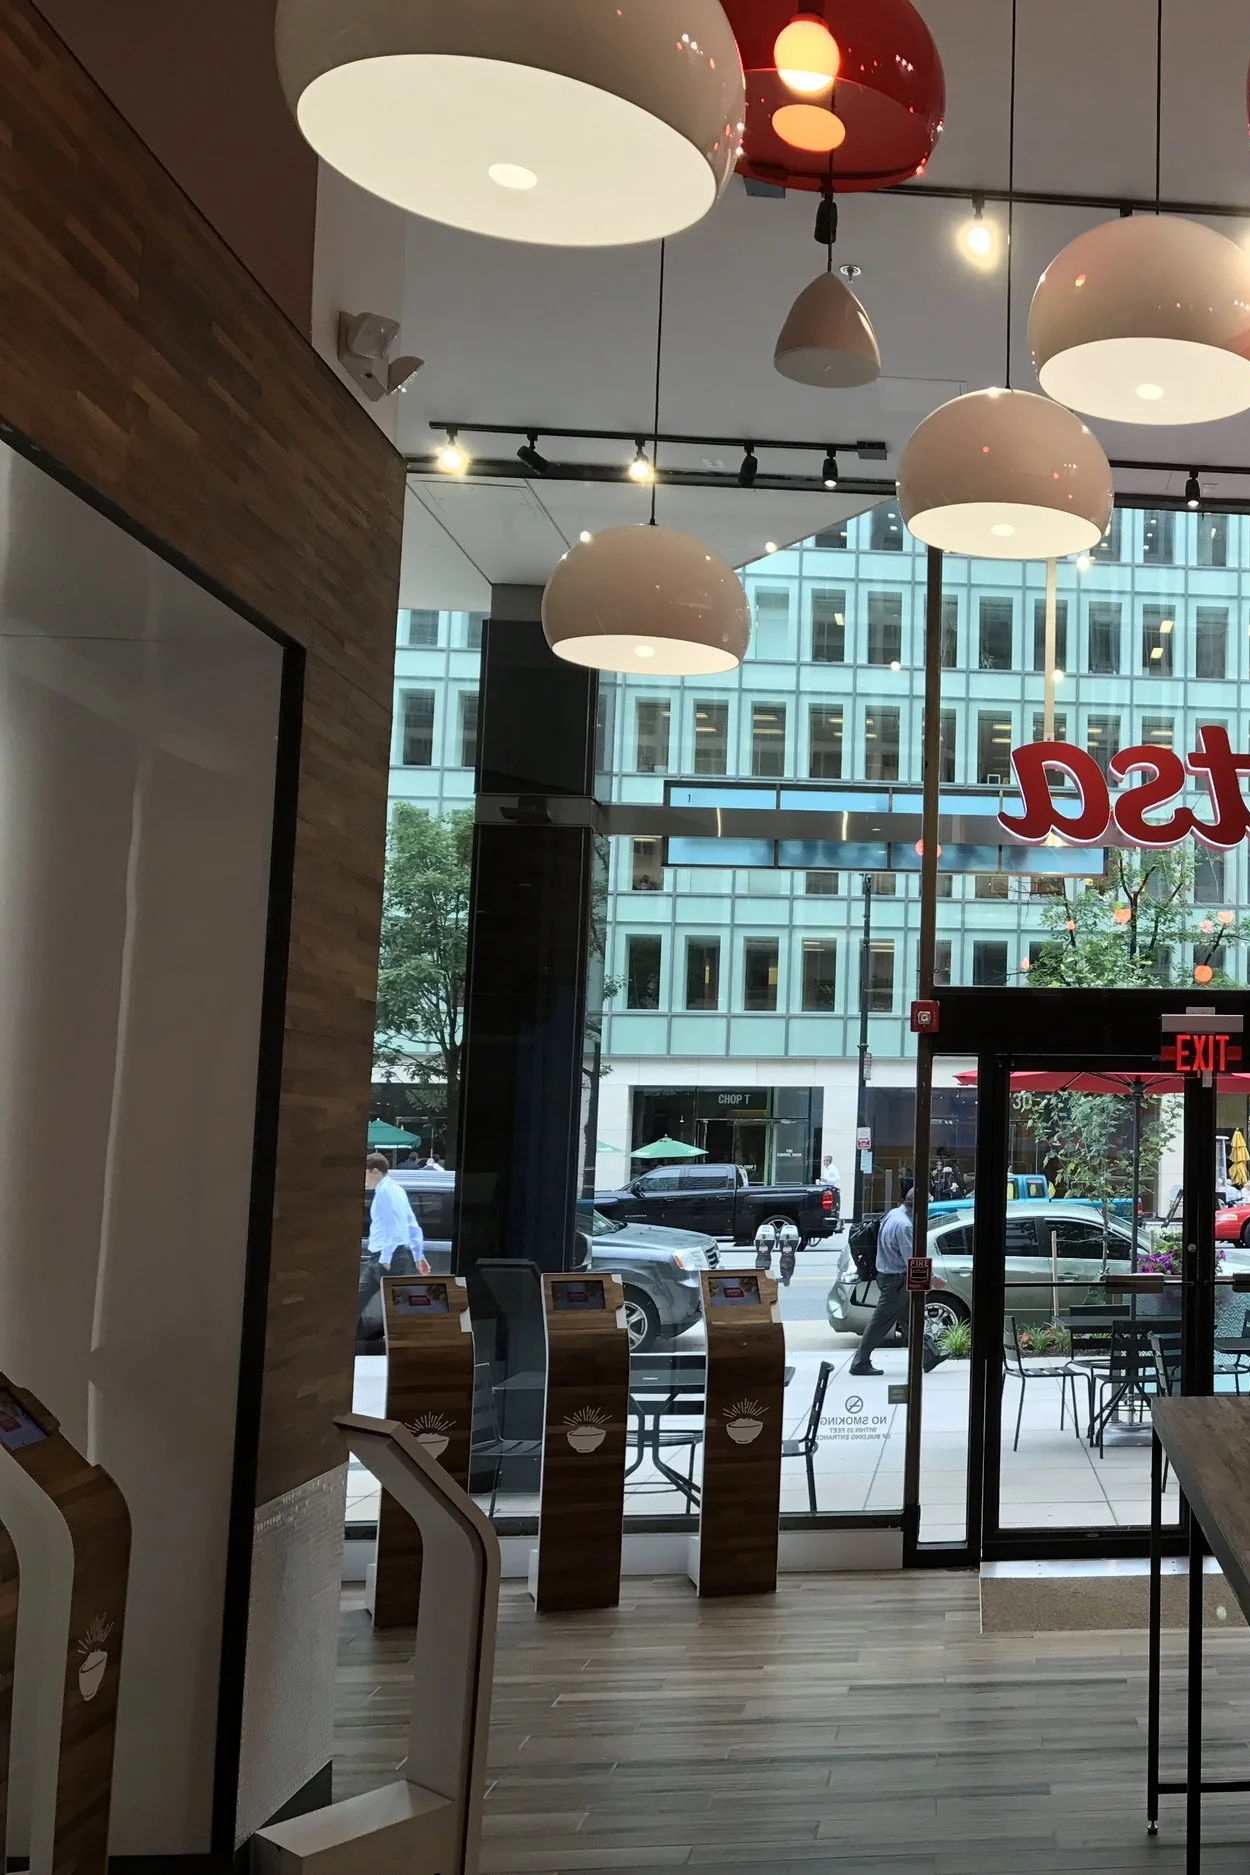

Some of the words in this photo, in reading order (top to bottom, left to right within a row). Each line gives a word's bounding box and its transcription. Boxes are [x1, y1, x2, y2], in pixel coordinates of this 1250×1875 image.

[1176, 1034, 1229, 1071] EXIT
[718, 1094, 743, 1104] CHOP
[744, 1094, 751, 1104] T
[910, 1259, 929, 1267] FIRE
